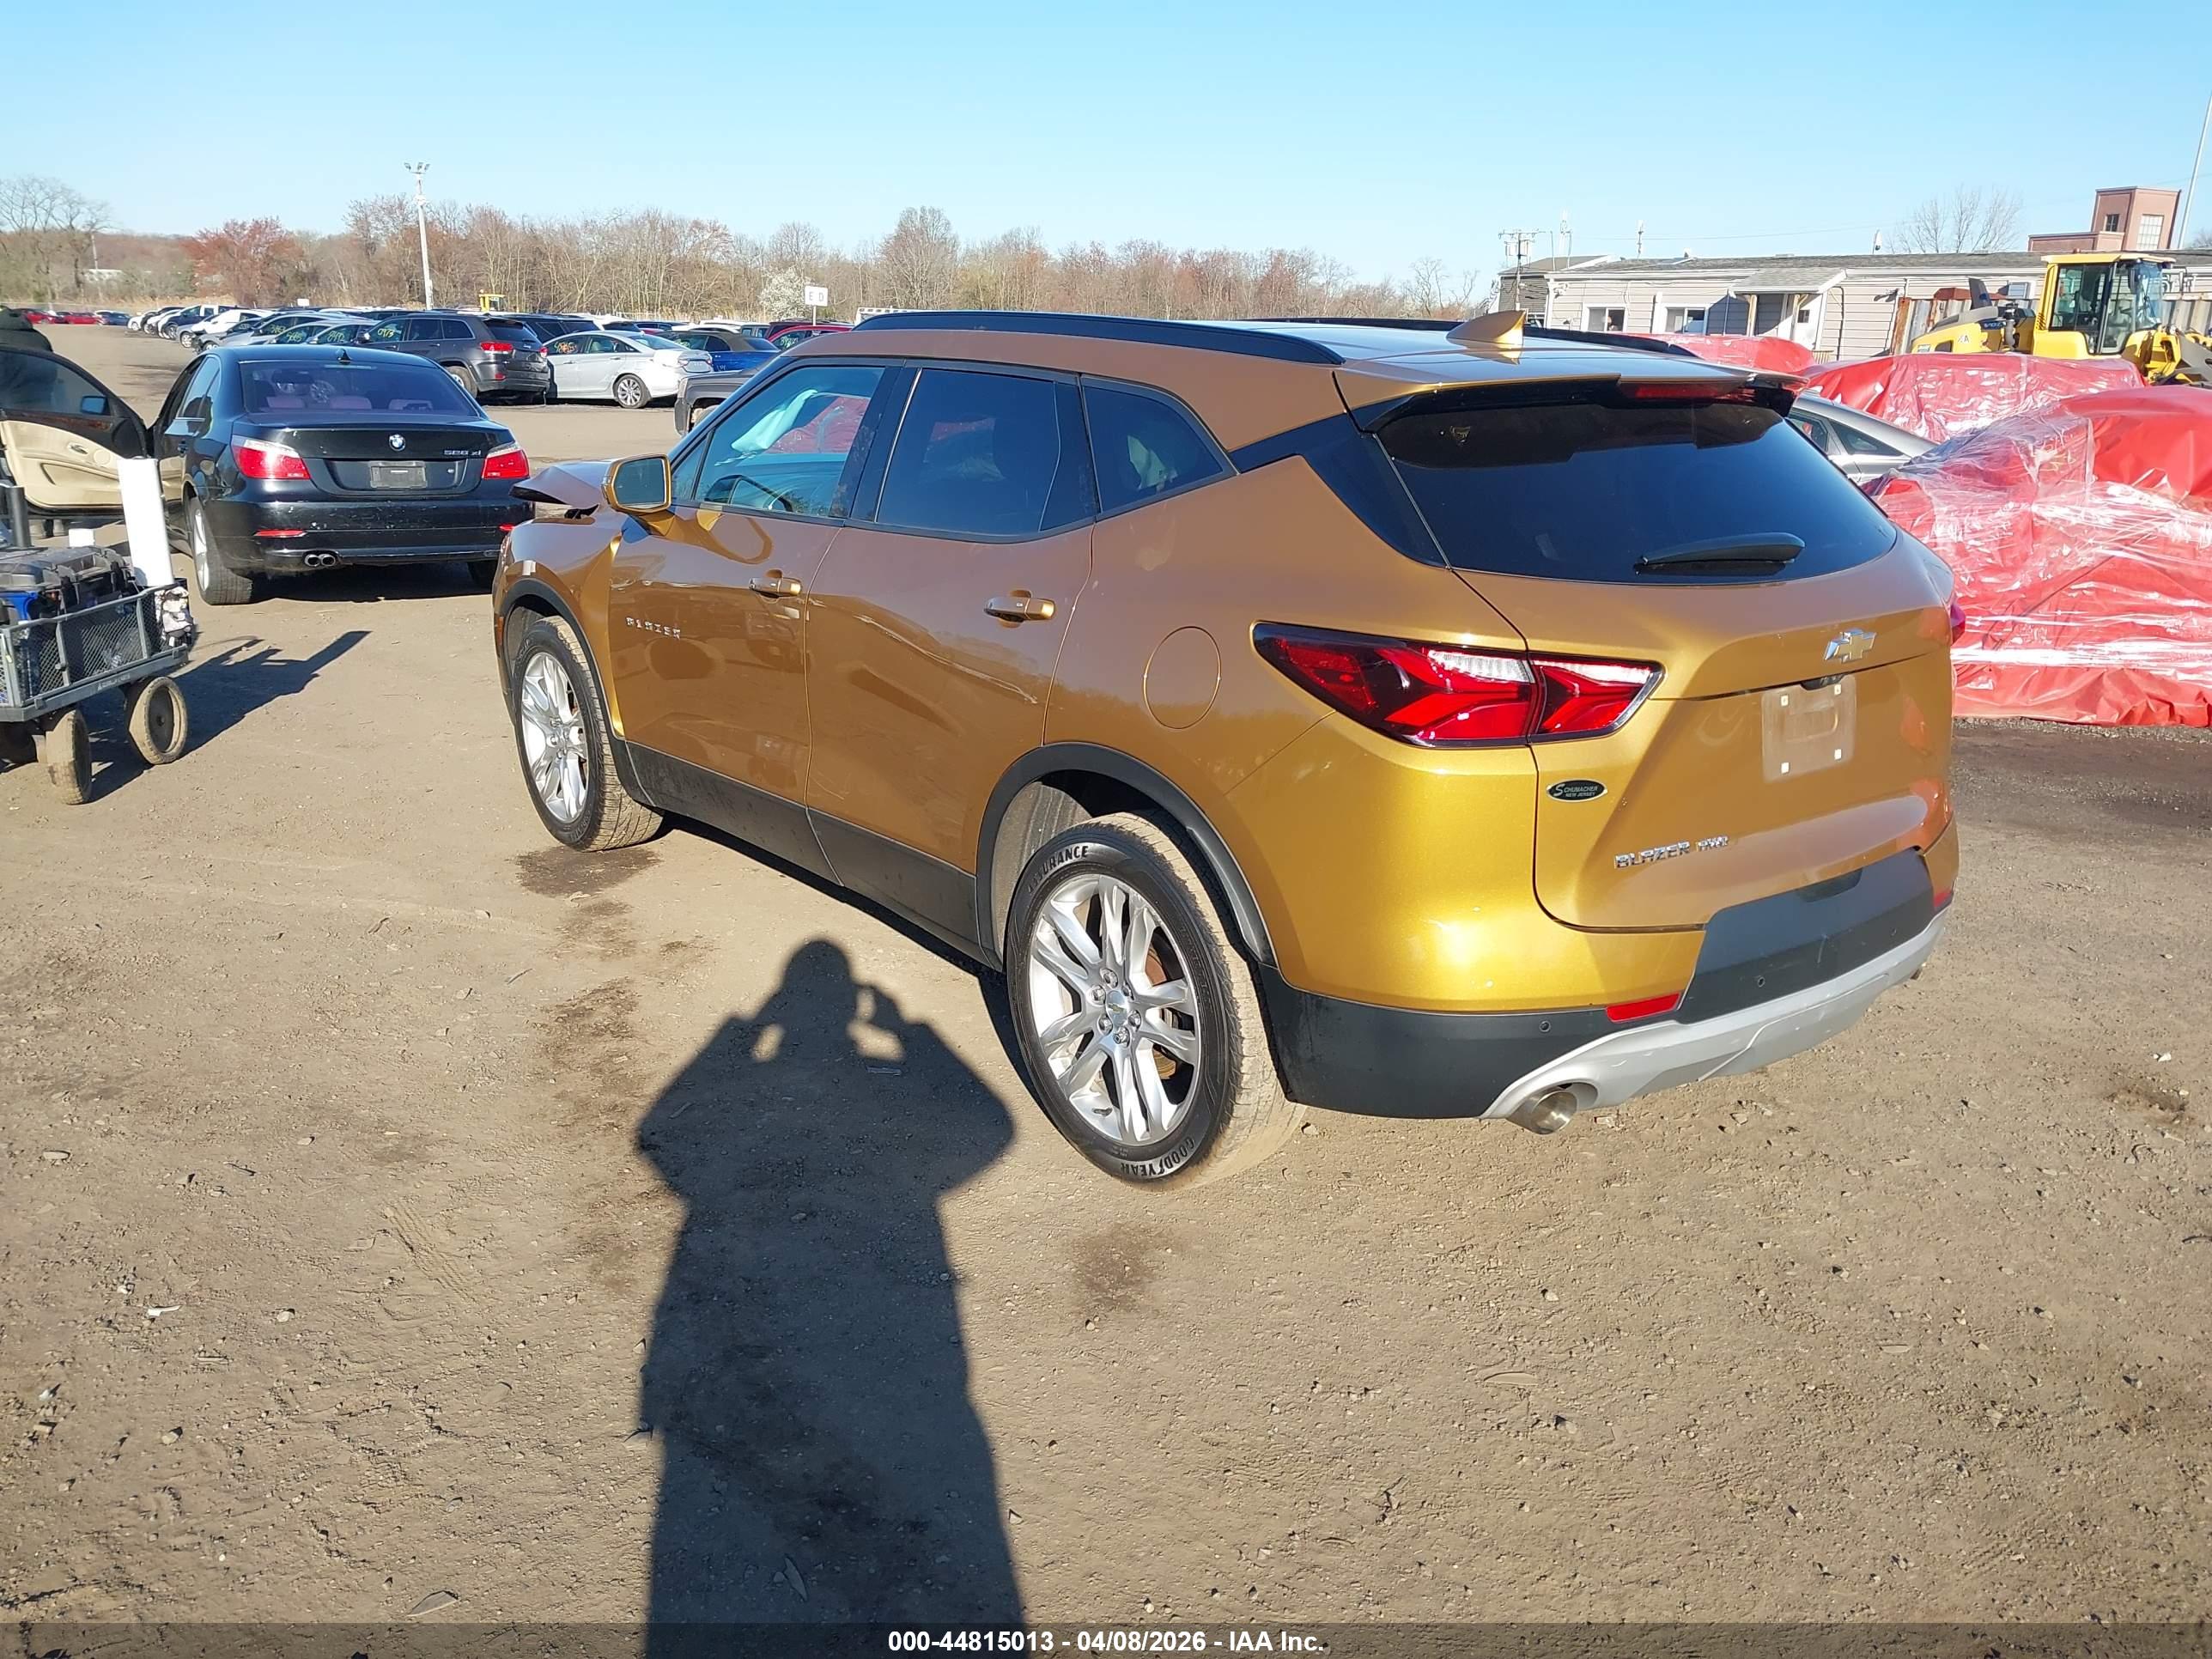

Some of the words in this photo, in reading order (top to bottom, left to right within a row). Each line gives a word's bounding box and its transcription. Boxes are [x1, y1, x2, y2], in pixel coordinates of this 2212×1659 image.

[626, 617, 681, 640] BLAZER
[1553, 783, 1598, 797] SCHUMACHER
[1614, 840, 1690, 869] BLAZER
[1120, 1136, 1195, 1176] GOODYEAR
